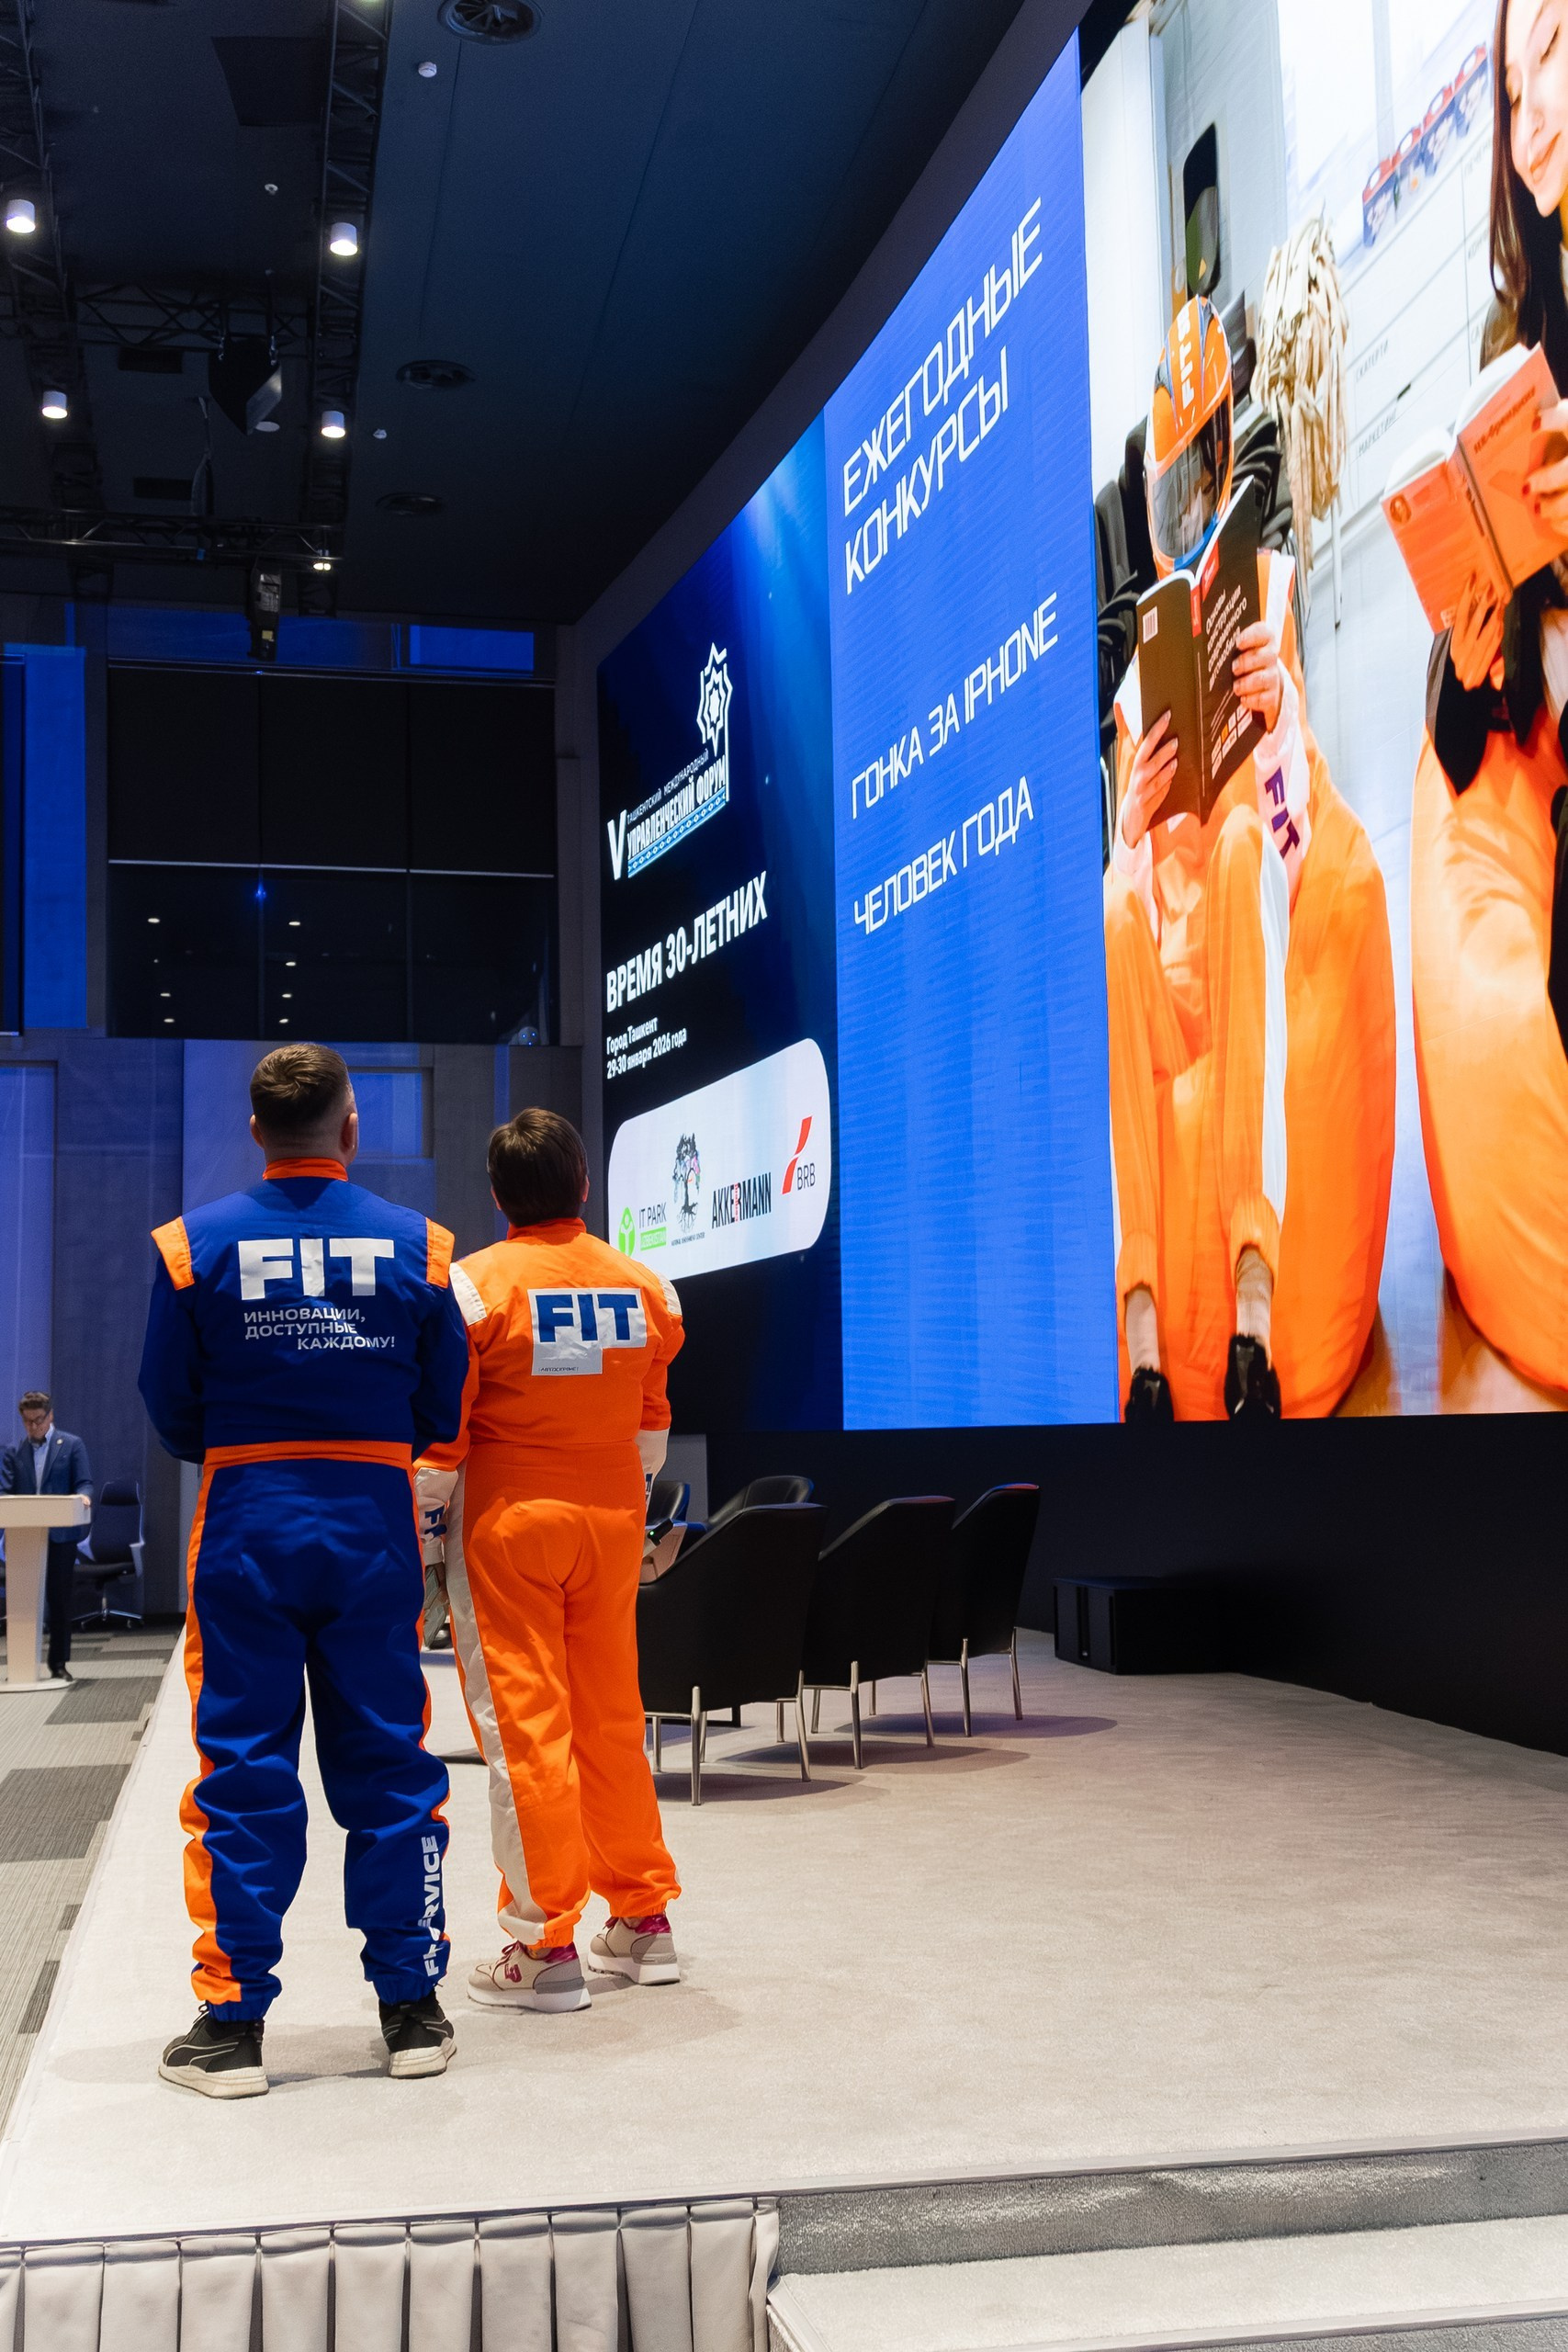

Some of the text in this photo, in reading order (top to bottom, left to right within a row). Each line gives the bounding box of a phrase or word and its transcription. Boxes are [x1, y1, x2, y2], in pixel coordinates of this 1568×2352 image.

[842, 196, 1043, 517] ЕЖЕГОДНЫЕ
[844, 345, 1009, 595] КОНКУРСЫ
[851, 591, 1058, 820] ГОНКА ЗА IPHONE
[627, 754, 727, 860] УПРАВЛЕНЧЕСКИЙ ФОРУМ
[607, 808, 627, 880] V
[853, 775, 1034, 935] ЧЕЛОВЕК ГОДА
[606, 870, 768, 1013] ВРЕМЯ 30-ЛЕТНИХ
[606, 1016, 659, 1057] Город Ташкент
[606, 1027, 688, 1080] 29-30 января 2026 года
[711, 1171, 772, 1229] AKKERMANN
[796, 1162, 816, 1192] BRB
[638, 1201, 667, 1229] IT PARK
[237, 1238, 395, 1301] FIT
[243, 1306, 367, 1324] ИННОВАЦИИ,
[244, 1321, 358, 1340] ДОСТУПНЫЕ
[297, 1335, 396, 1351] КАЖДОМУ!
[535, 1293, 639, 1343] FIT
